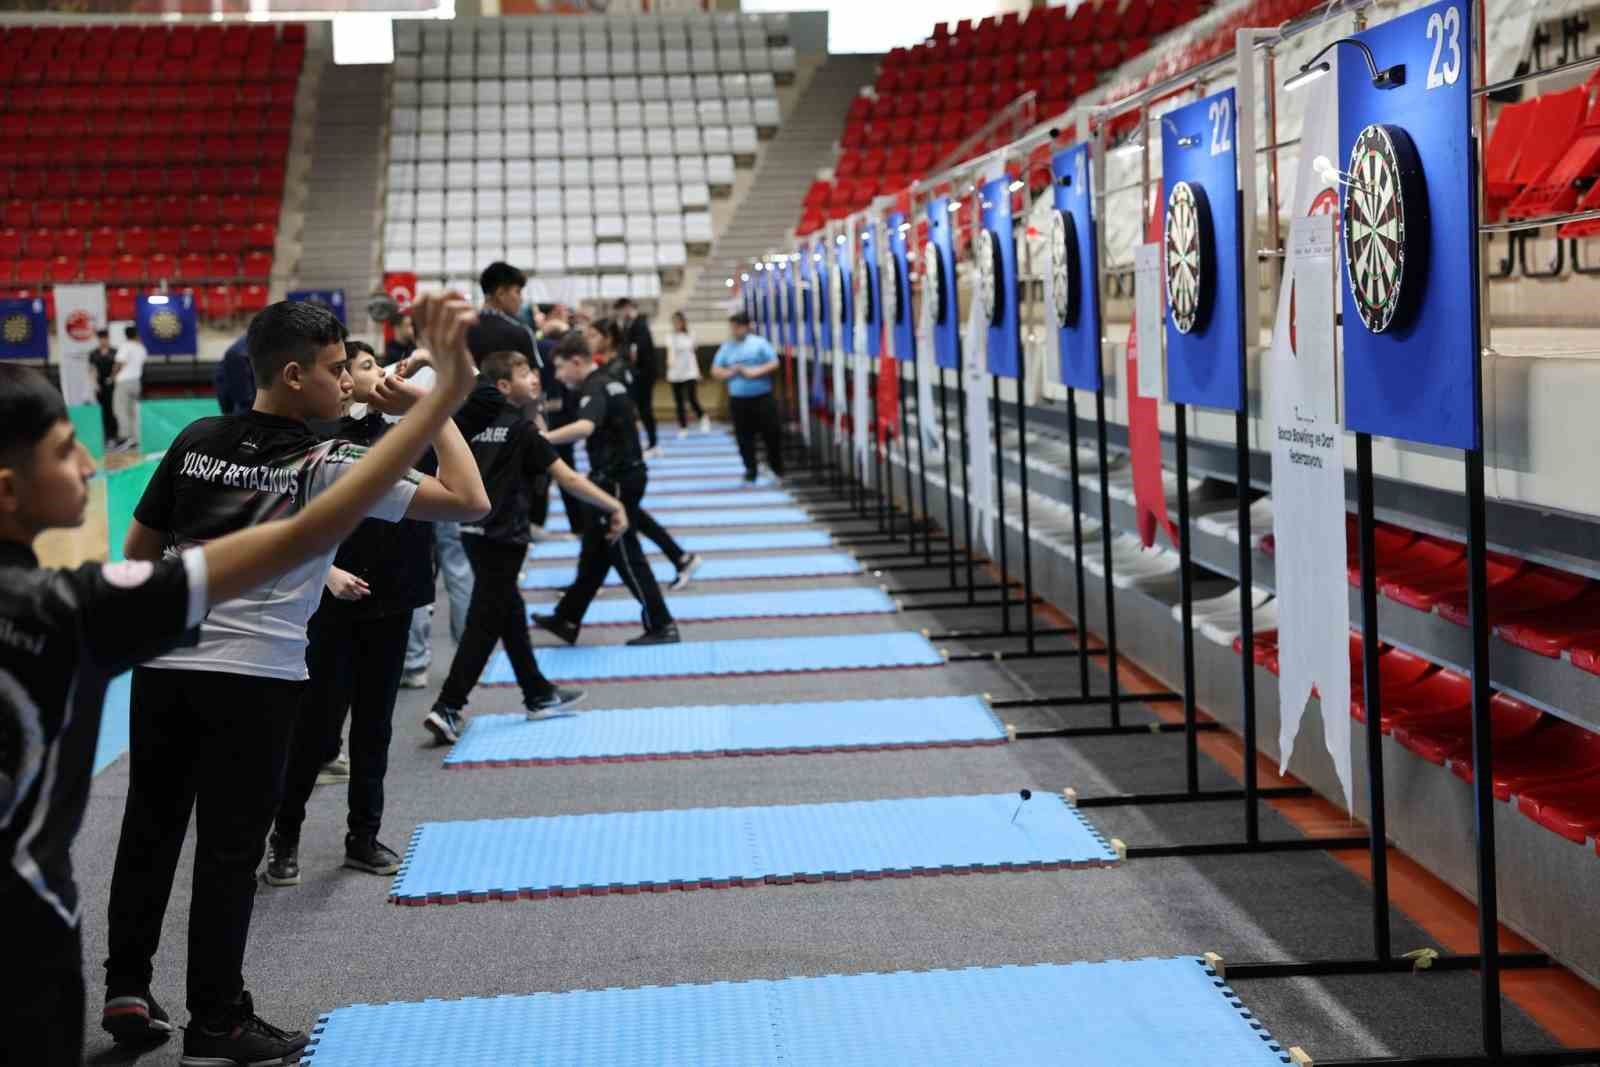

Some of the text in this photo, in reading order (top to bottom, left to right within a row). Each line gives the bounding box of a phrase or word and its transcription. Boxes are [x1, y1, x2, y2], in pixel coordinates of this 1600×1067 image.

[1426, 6, 1461, 89] 23
[1209, 97, 1231, 156] 22
[180, 451, 299, 504] YUSUF BEYAZKUŞ
